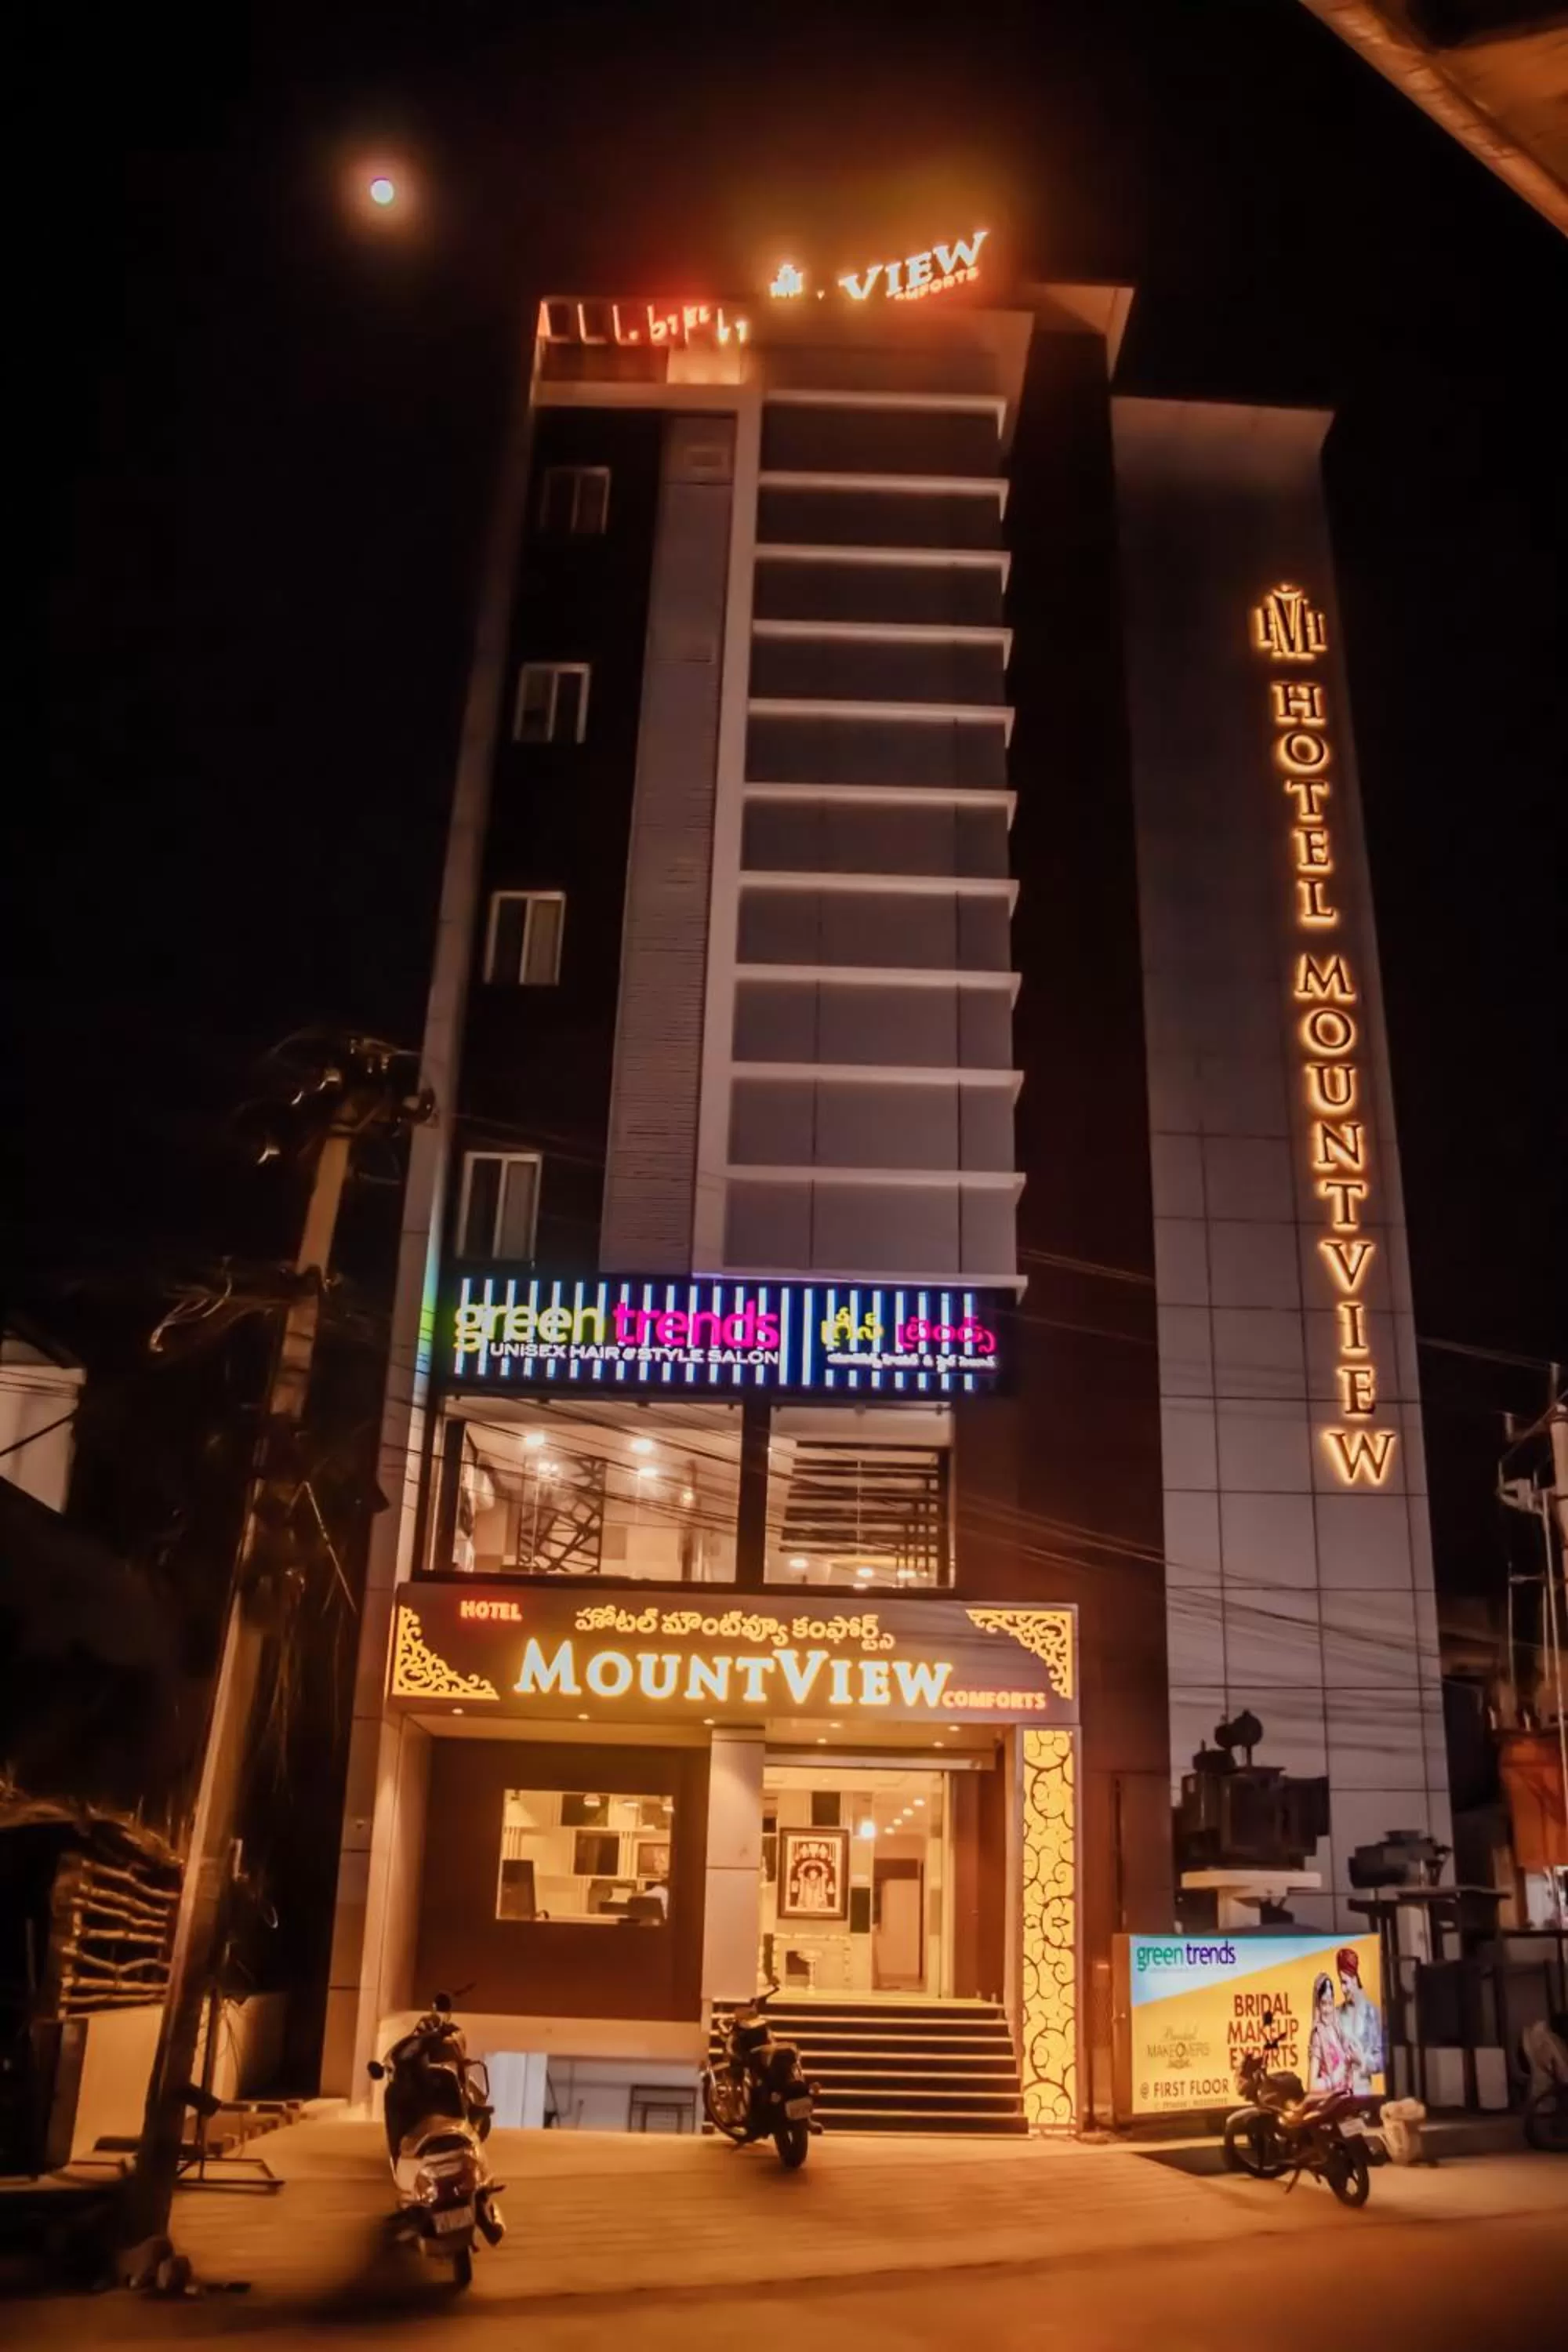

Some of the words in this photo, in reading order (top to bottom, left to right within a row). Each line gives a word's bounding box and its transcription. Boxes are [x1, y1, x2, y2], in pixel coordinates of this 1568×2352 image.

[1272, 681, 1337, 927] HOTEL
[1294, 952, 1396, 1486] MOUNTVIEW
[453, 1302, 606, 1352] green
[612, 1299, 779, 1348] trends
[490, 1343, 566, 1359] UNISEX
[569, 1345, 619, 1360] HAIR
[637, 1347, 705, 1363] STYLE
[708, 1350, 779, 1365] SALON
[460, 1600, 523, 1622] HOTEL
[942, 1690, 1047, 1710] COMFORTS
[1137, 1946, 1183, 1972] green
[1185, 1938, 1236, 1965] trends
[1234, 1992, 1292, 2017] BRIDAL
[1153, 2080, 1185, 2098] FIRST
[1189, 2078, 1230, 2096] FLOOR
